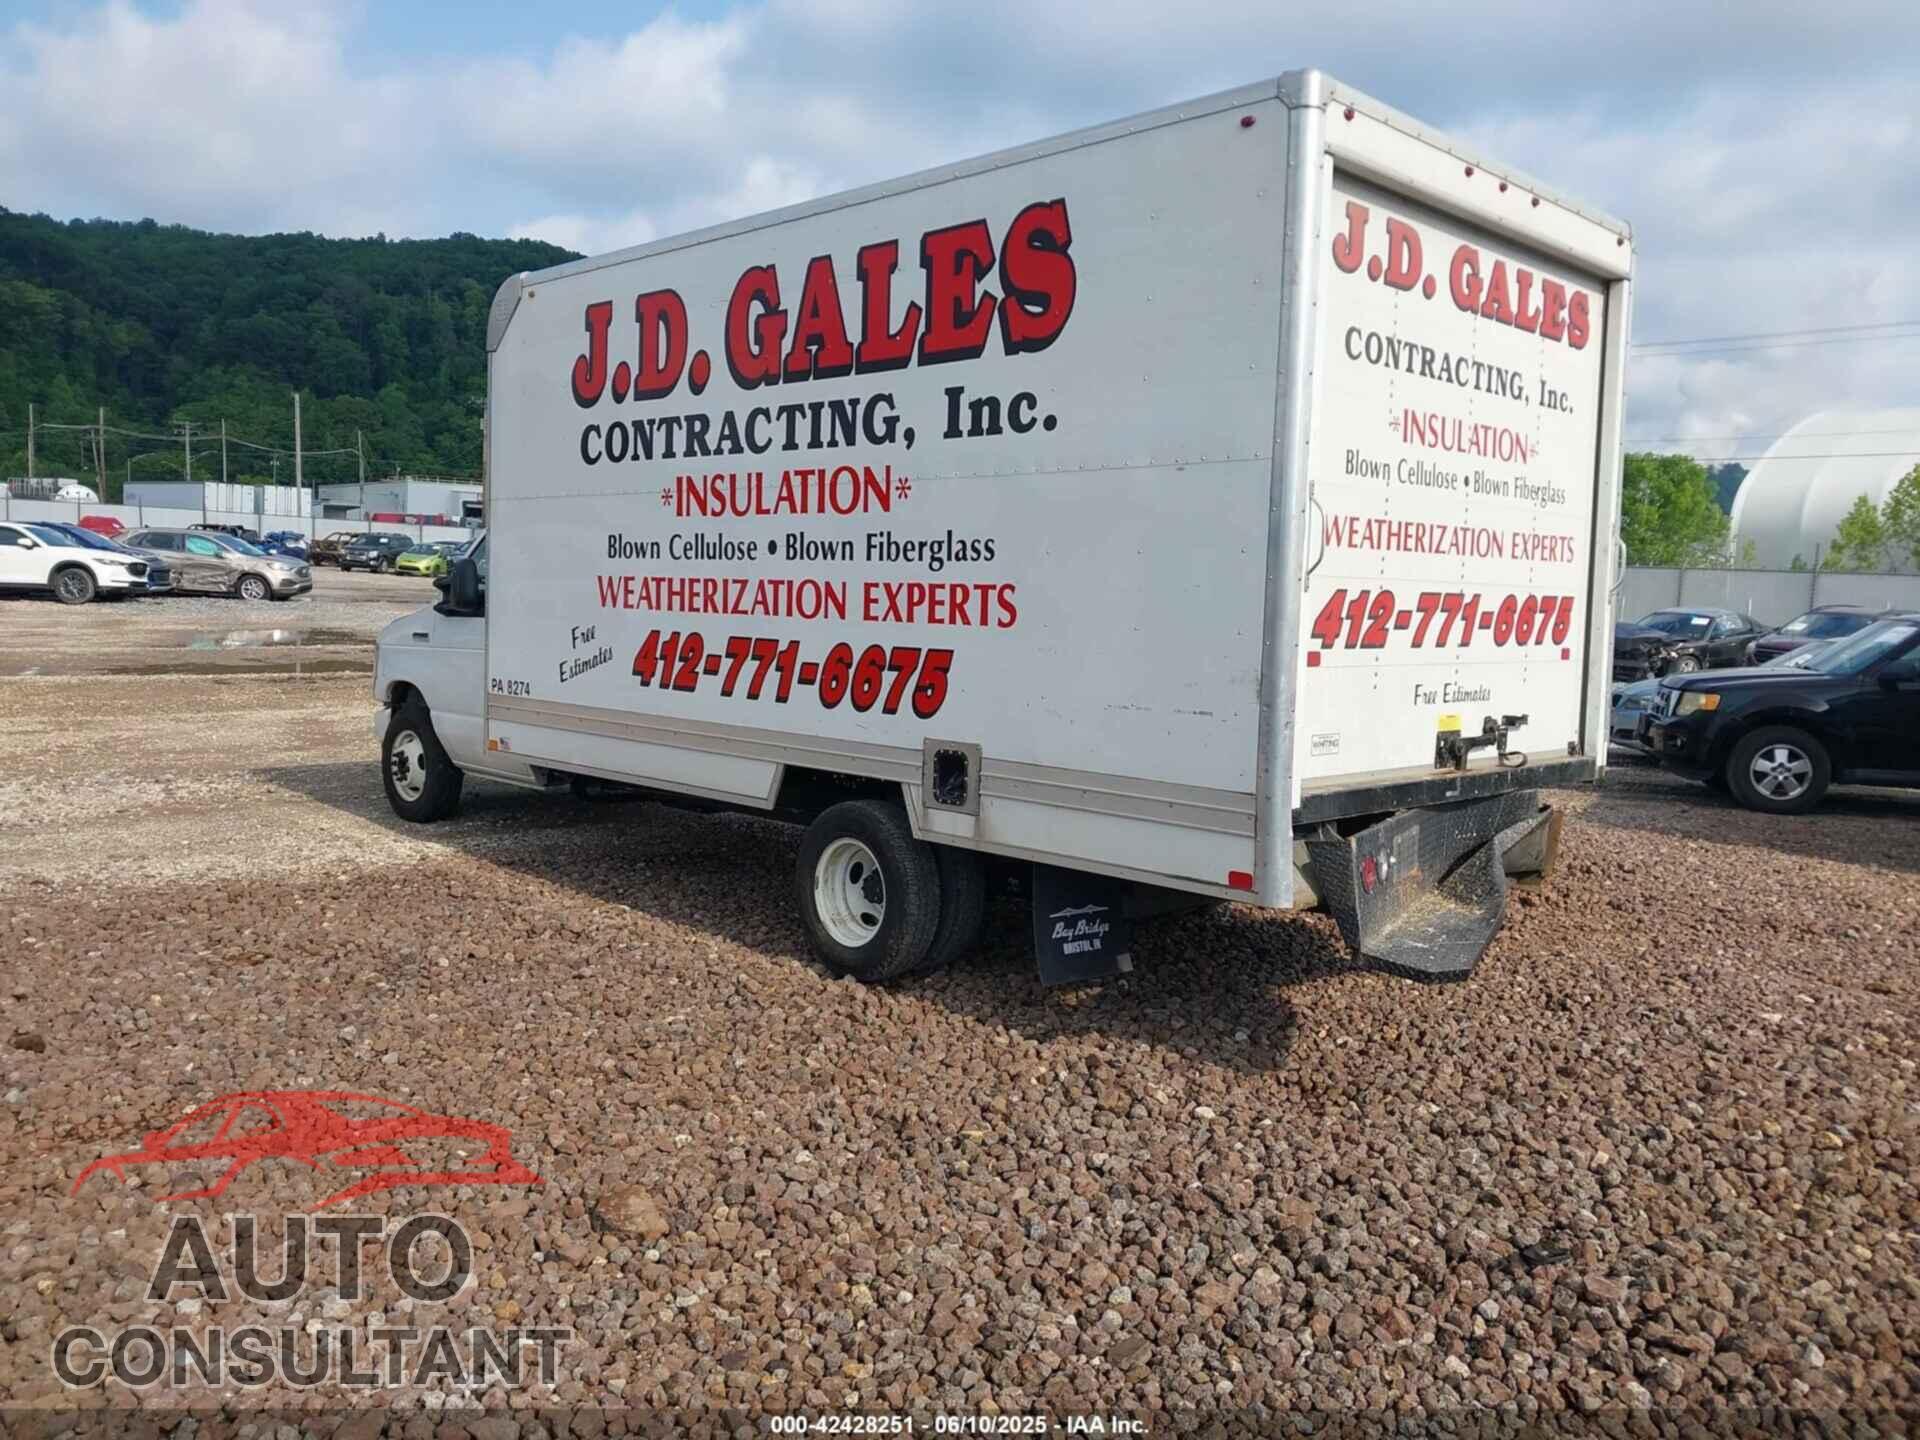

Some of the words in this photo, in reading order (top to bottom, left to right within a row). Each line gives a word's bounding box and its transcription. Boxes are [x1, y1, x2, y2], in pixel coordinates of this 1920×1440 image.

[1332, 200, 1437, 300] J.D.
[1450, 244, 1590, 350] GALES
[572, 287, 711, 409] J.D.
[725, 198, 1078, 390] GALES
[1345, 326, 1529, 407] CONTRACTING,
[1539, 379, 1574, 414] Inc.
[580, 392, 916, 466] CONTRACTING,
[943, 386, 1058, 439] Inc.
[1345, 449, 1391, 482] Blown
[1397, 458, 1458, 491] Cellulose
[1473, 470, 1510, 498] Blown
[1514, 476, 1566, 508] Fiberglass
[608, 534, 661, 561] Blown
[668, 534, 758, 562] Cellulose
[785, 532, 855, 563] Blown
[865, 530, 996, 572] Fiberglass
[1323, 515, 1504, 559] WEATHERIZATION
[1511, 532, 1575, 564] EXPERTS
[597, 575, 847, 620] WEATHERIZATION
[863, 582, 1018, 628] EXPERTS
[1311, 589, 1575, 649] 412-771-6675
[559, 646, 614, 683] Estimates
[571, 625, 597, 649] Free
[491, 678, 504, 693] PA
[507, 680, 531, 696] 8274
[631, 630, 955, 720] 412-771-6675
[1414, 683, 1438, 705] Free
[1443, 682, 1491, 703] Estimates
